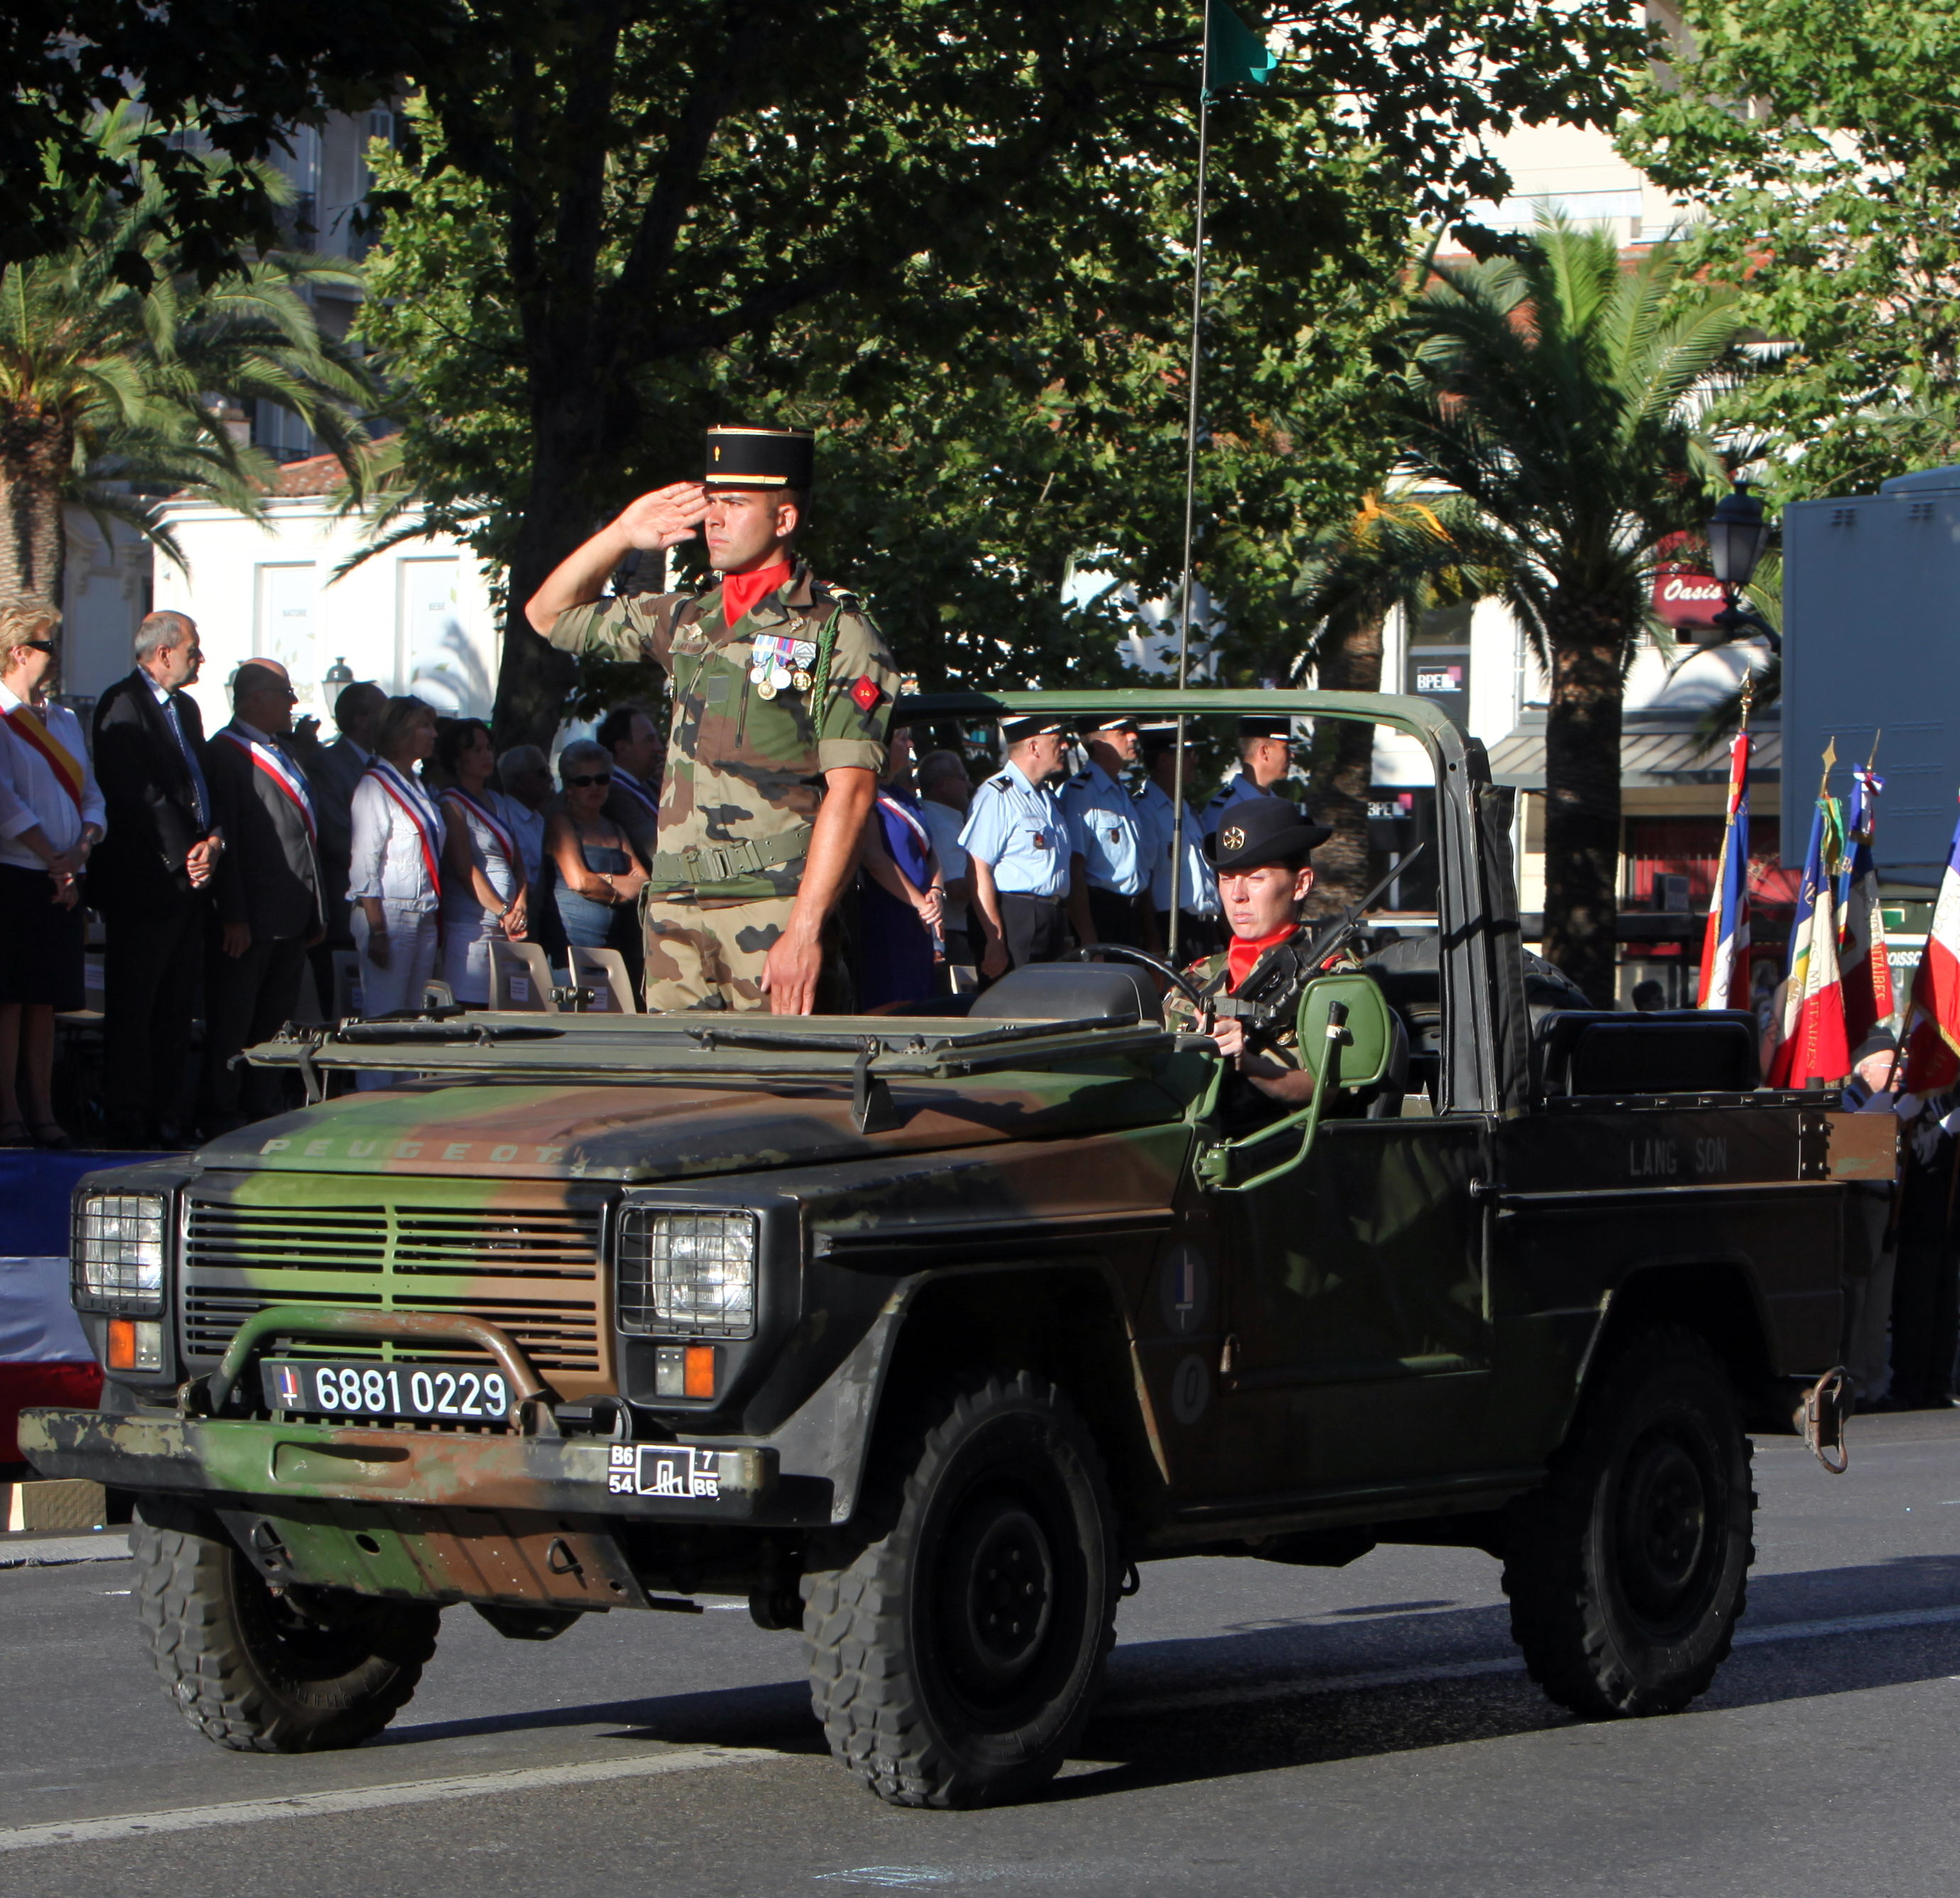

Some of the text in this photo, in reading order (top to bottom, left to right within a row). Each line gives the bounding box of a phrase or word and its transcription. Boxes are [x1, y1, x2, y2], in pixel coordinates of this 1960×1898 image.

[1663, 579, 1721, 602] Oasis
[1417, 674, 1442, 689] BPE
[259, 1139, 564, 1163] PEUGEOT
[1630, 1137, 1727, 1176] LANG SON
[316, 1367, 507, 1416] 6881 0229
[612, 1446, 633, 1465] B6
[702, 1450, 714, 1470] 7
[609, 1475, 633, 1493] 54
[695, 1479, 719, 1497] BB
